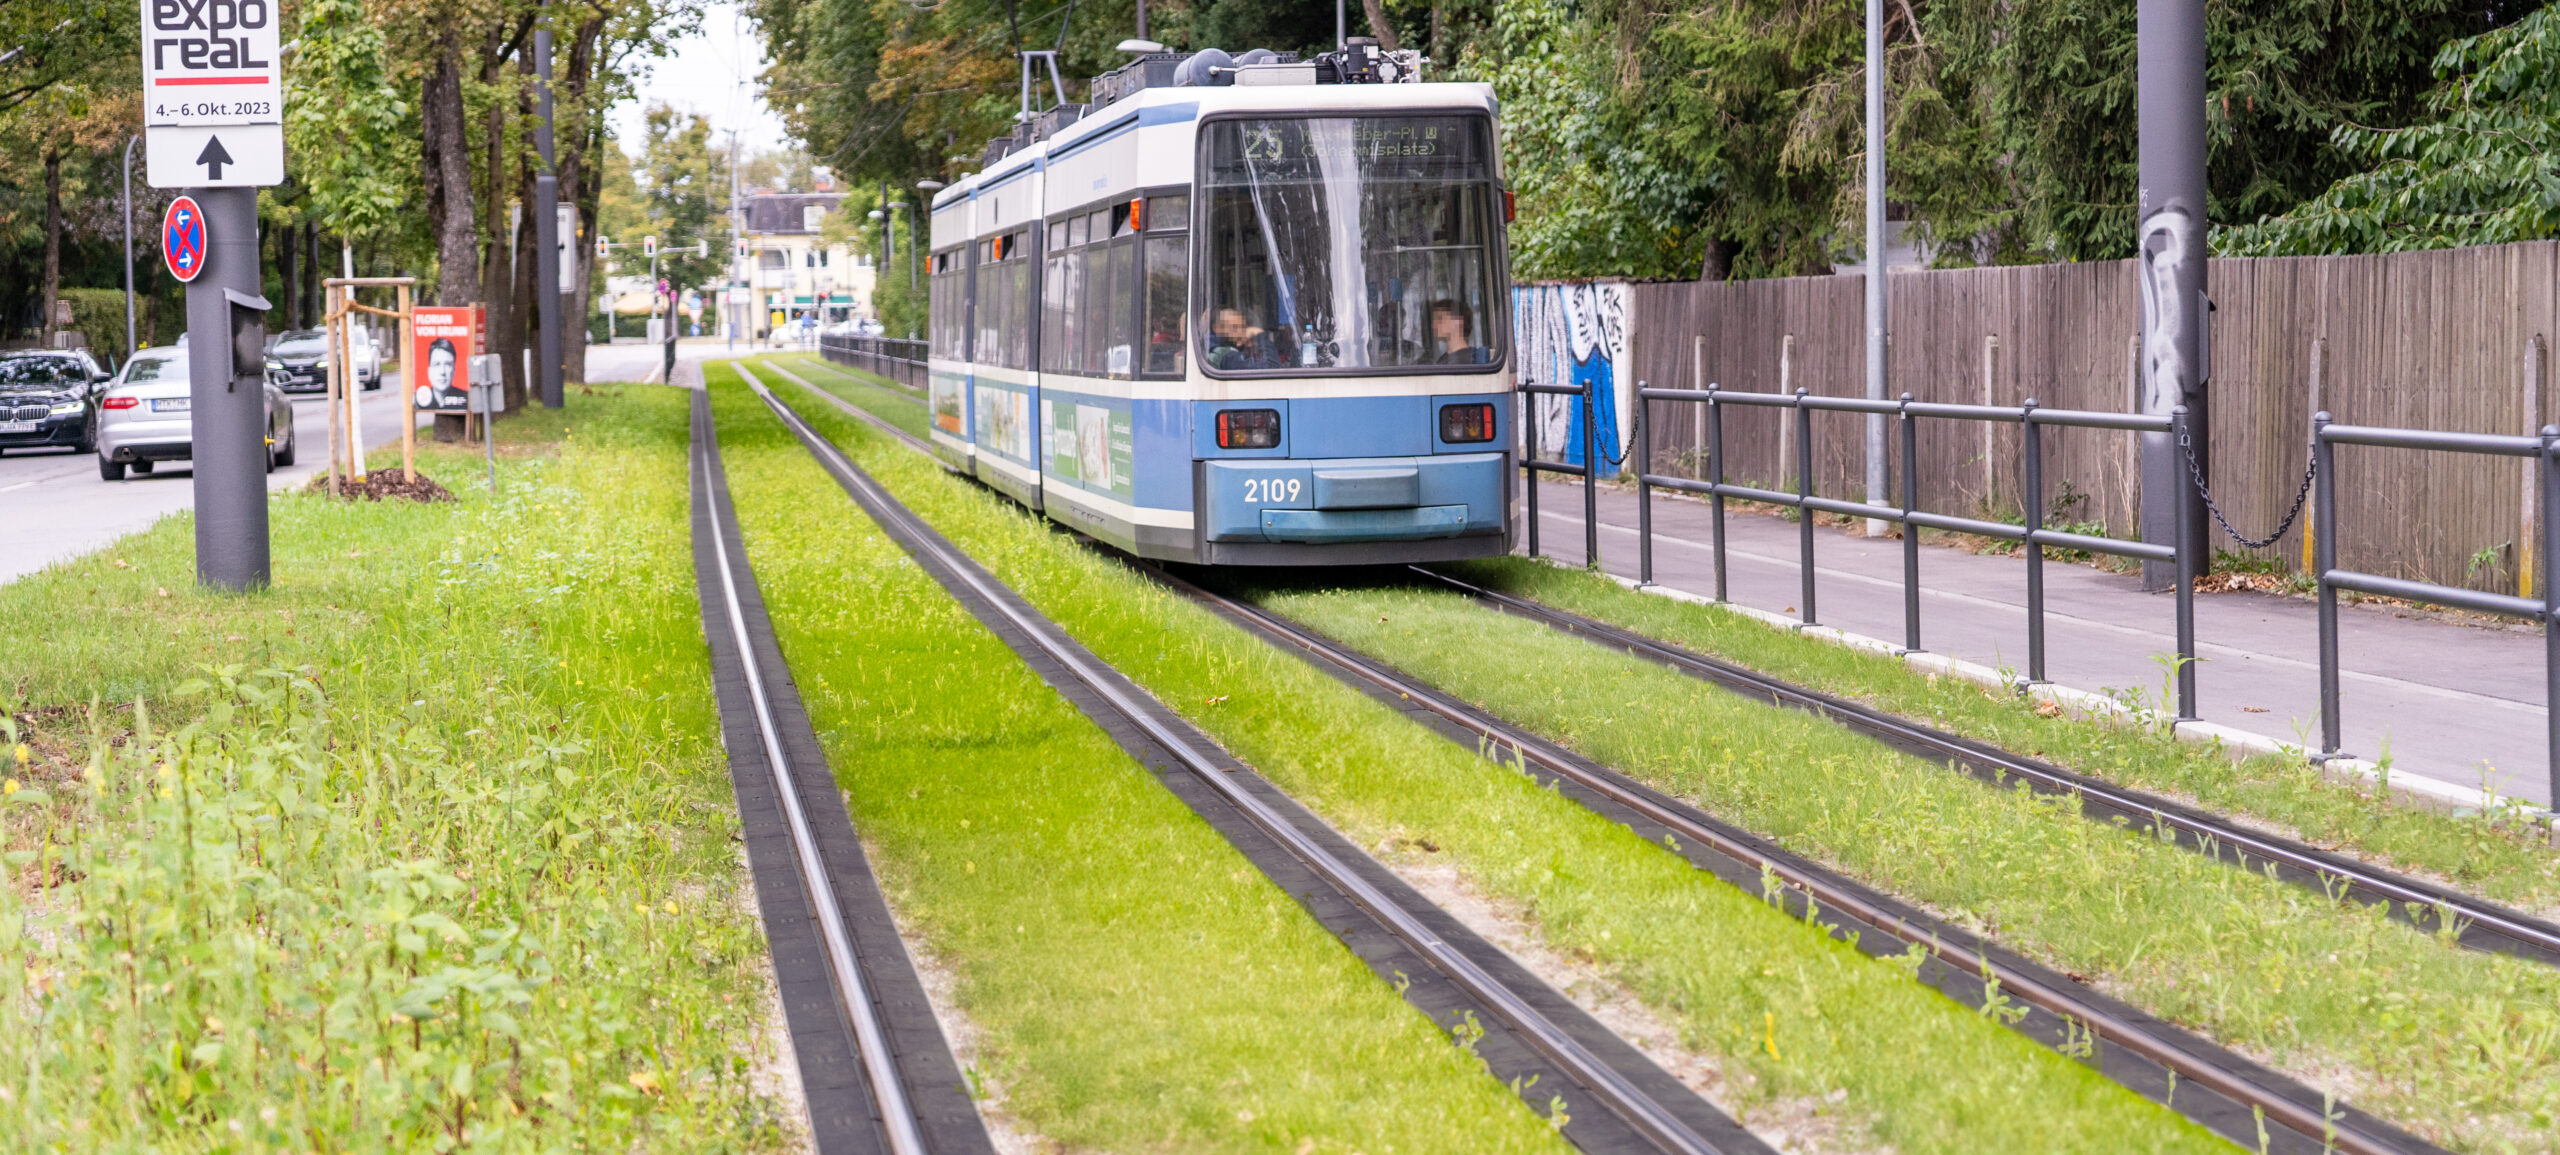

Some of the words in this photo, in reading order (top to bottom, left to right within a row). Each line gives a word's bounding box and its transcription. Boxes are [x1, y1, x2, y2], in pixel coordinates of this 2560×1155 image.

[197, 102, 231, 116] Okt.
[234, 102, 270, 115] 2023
[415, 326, 436, 337] VON
[1244, 478, 1301, 503] 2109
